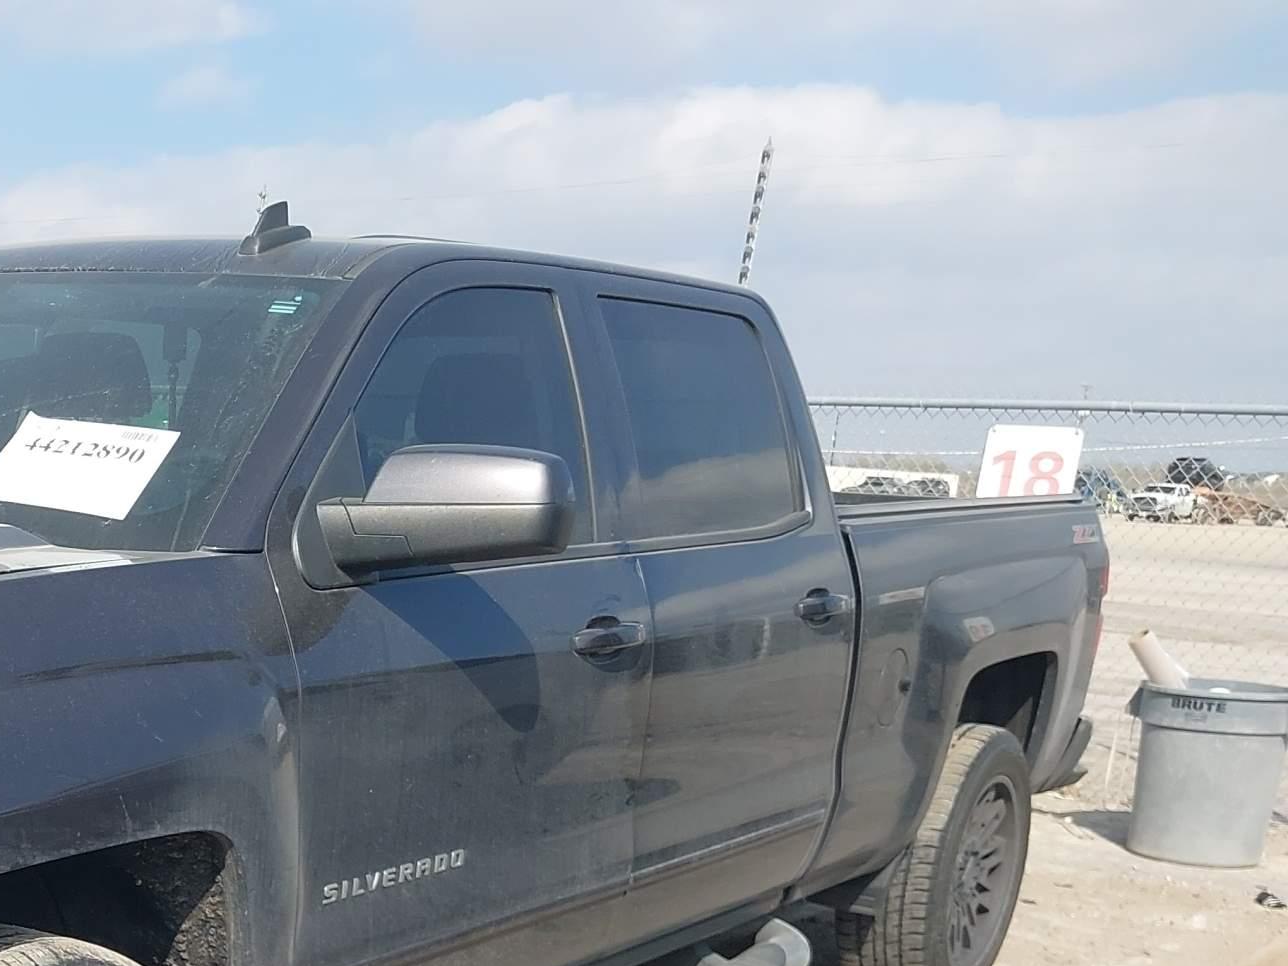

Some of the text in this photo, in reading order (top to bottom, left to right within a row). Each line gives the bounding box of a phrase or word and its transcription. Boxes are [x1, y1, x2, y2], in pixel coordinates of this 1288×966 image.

[25, 437, 146, 463] 44212890
[992, 450, 1065, 497] 18
[1171, 696, 1227, 714] BRUTE
[322, 848, 465, 905] SILVERADO
